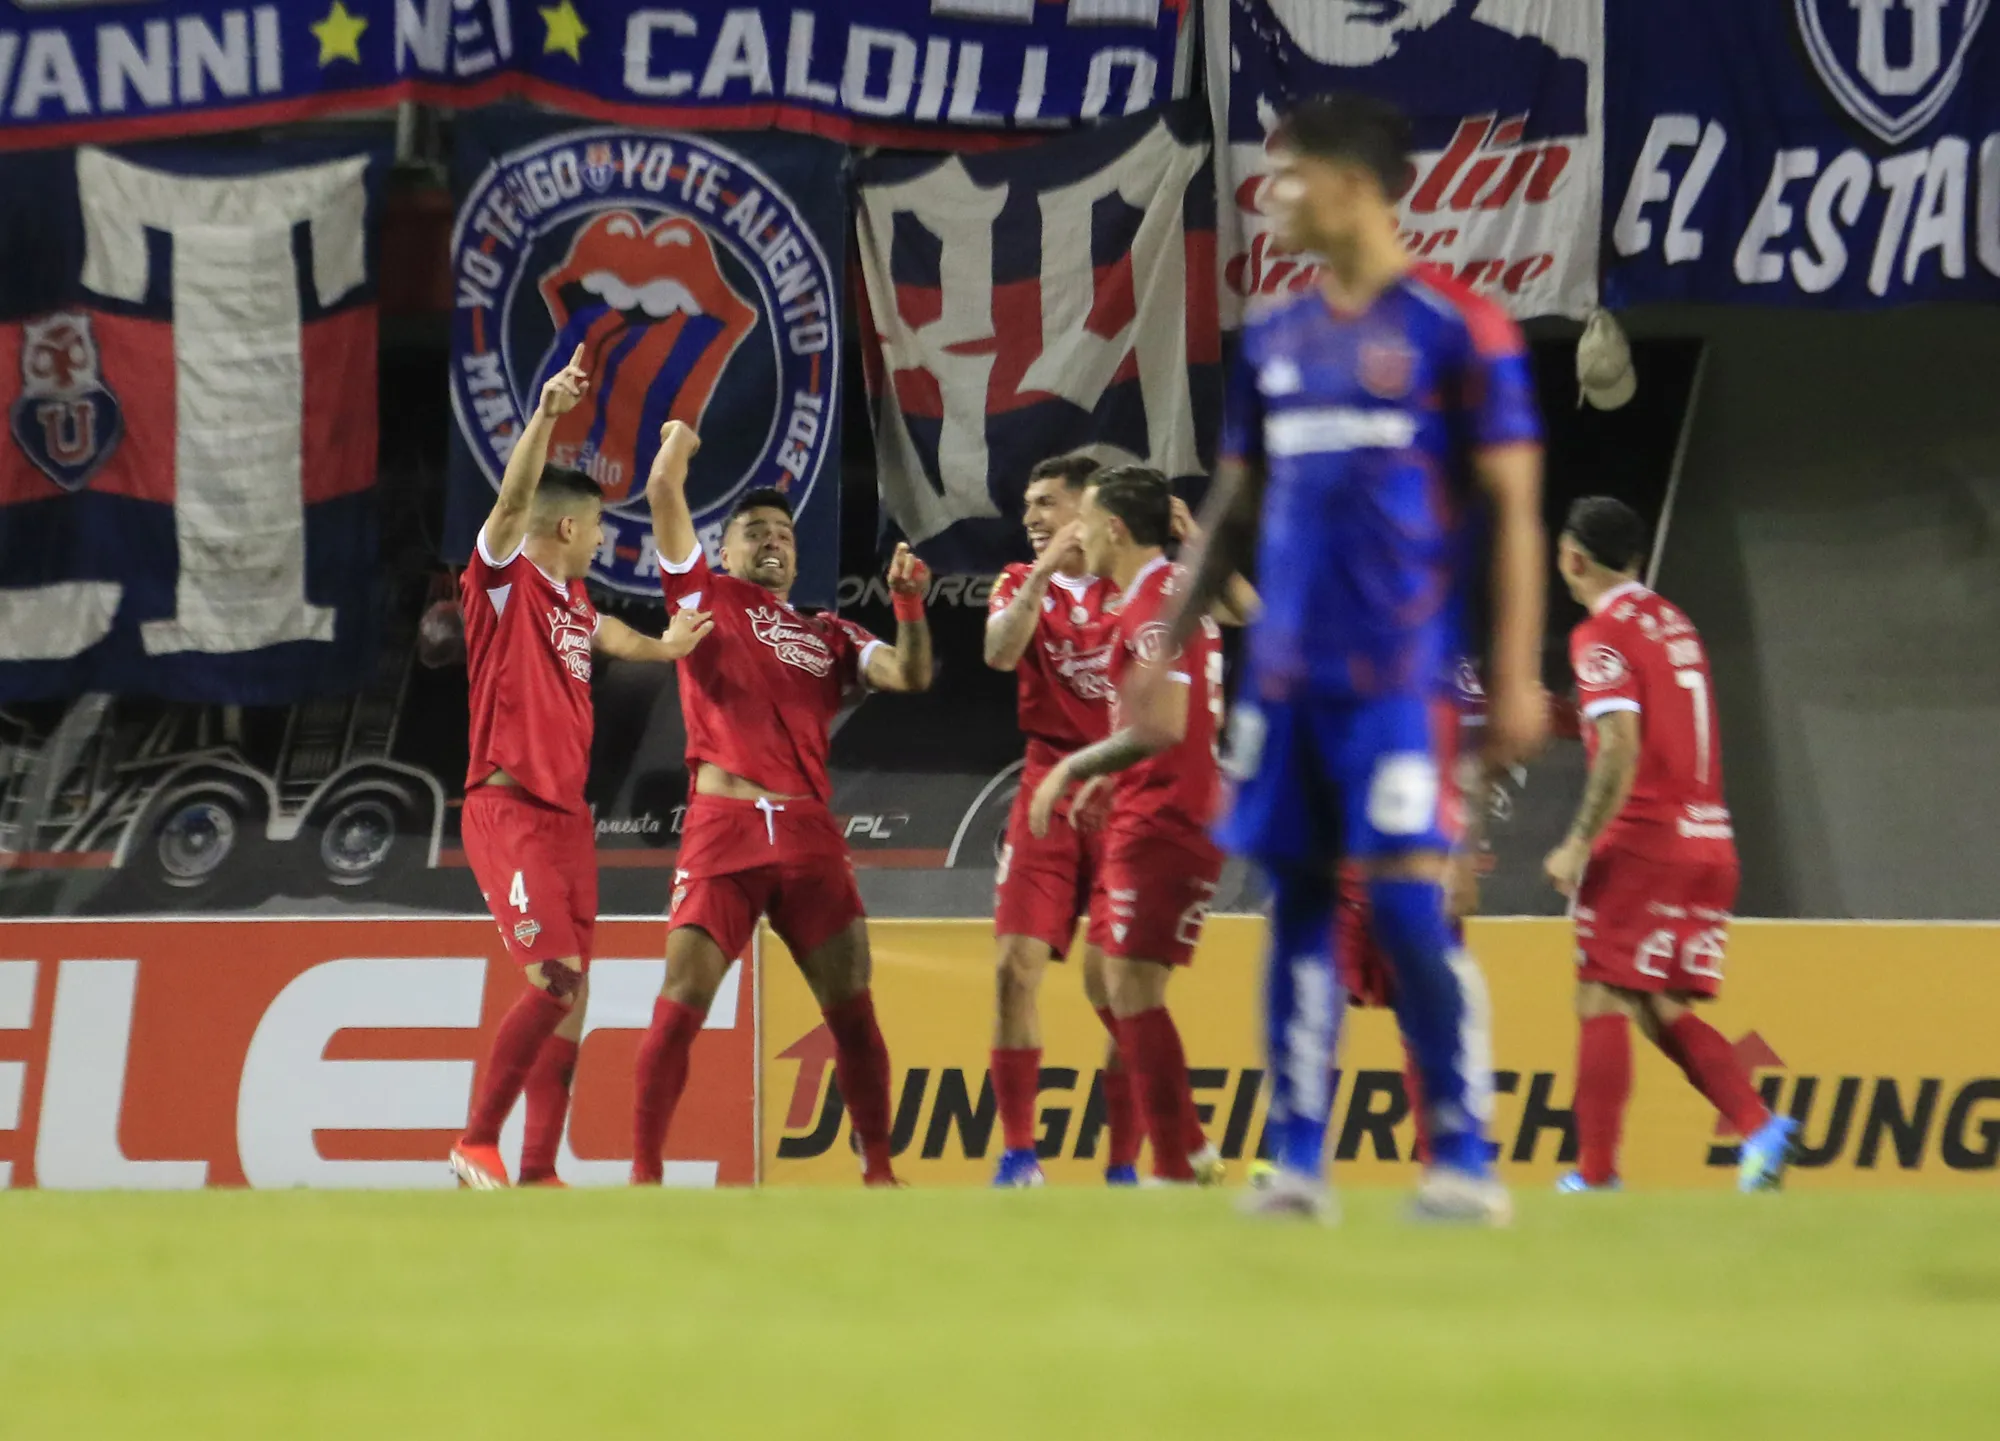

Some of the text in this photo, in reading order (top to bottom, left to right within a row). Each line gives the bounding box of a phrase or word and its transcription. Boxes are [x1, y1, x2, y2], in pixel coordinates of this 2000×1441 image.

[624, 7, 1158, 128] CALDILLO
[457, 247, 502, 309] YO
[621, 141, 673, 192] YO
[681, 152, 730, 213] TE
[722, 188, 829, 355] ALIENTO
[1612, 113, 1727, 265] EL
[508, 871, 529, 914] 4
[0, 957, 744, 1189] LEC
